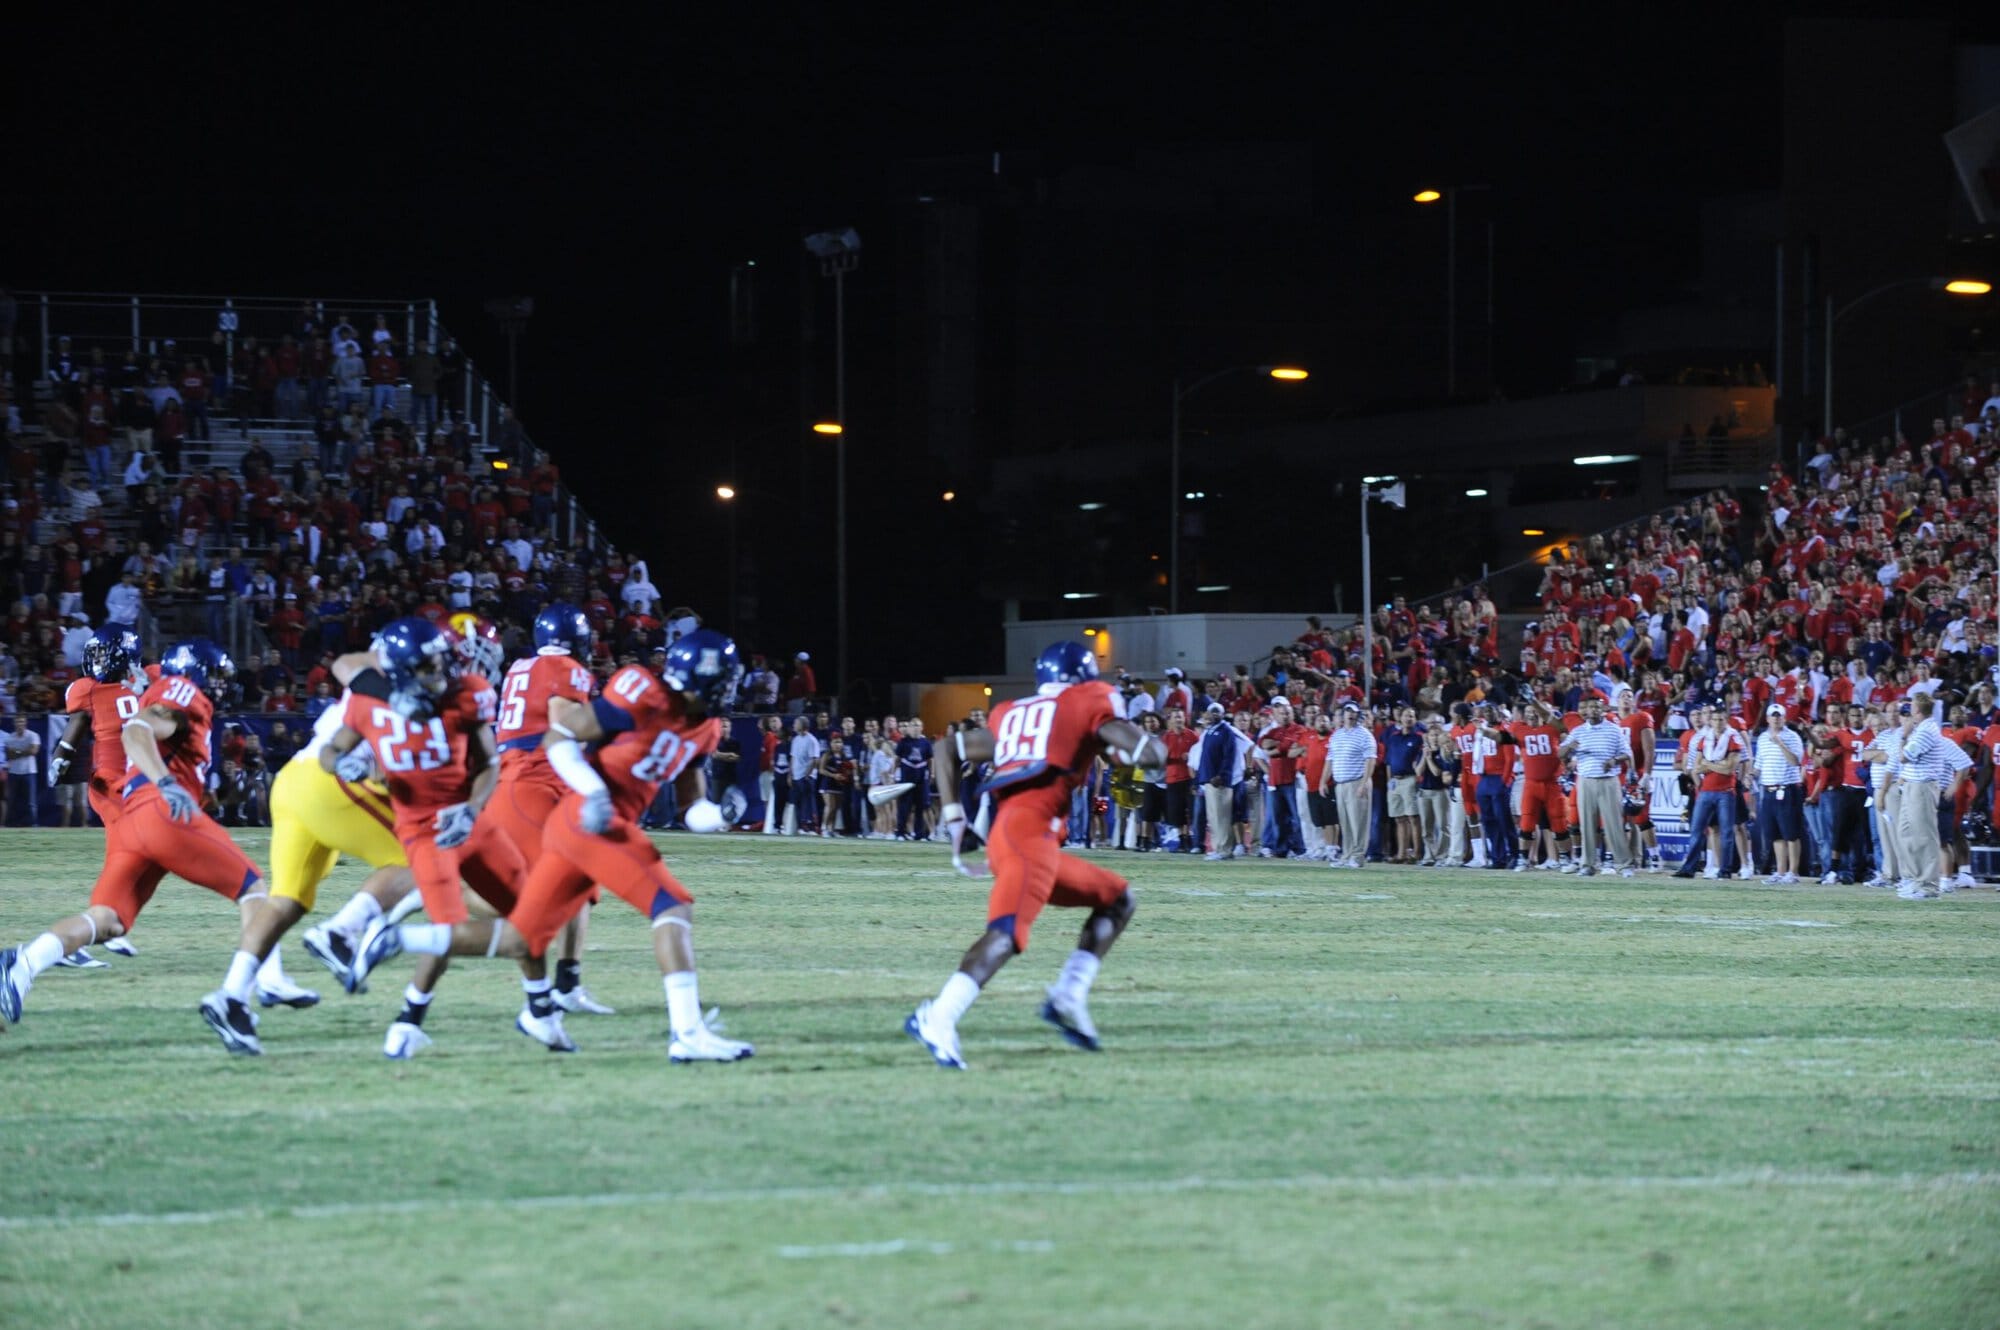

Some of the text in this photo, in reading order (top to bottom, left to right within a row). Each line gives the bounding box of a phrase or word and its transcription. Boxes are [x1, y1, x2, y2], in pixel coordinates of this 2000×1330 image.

[613, 669, 651, 703] 81
[371, 706, 450, 772] 23
[994, 700, 1058, 767] 89
[1524, 734, 1553, 756] 68
[1851, 740, 1865, 762] 3
